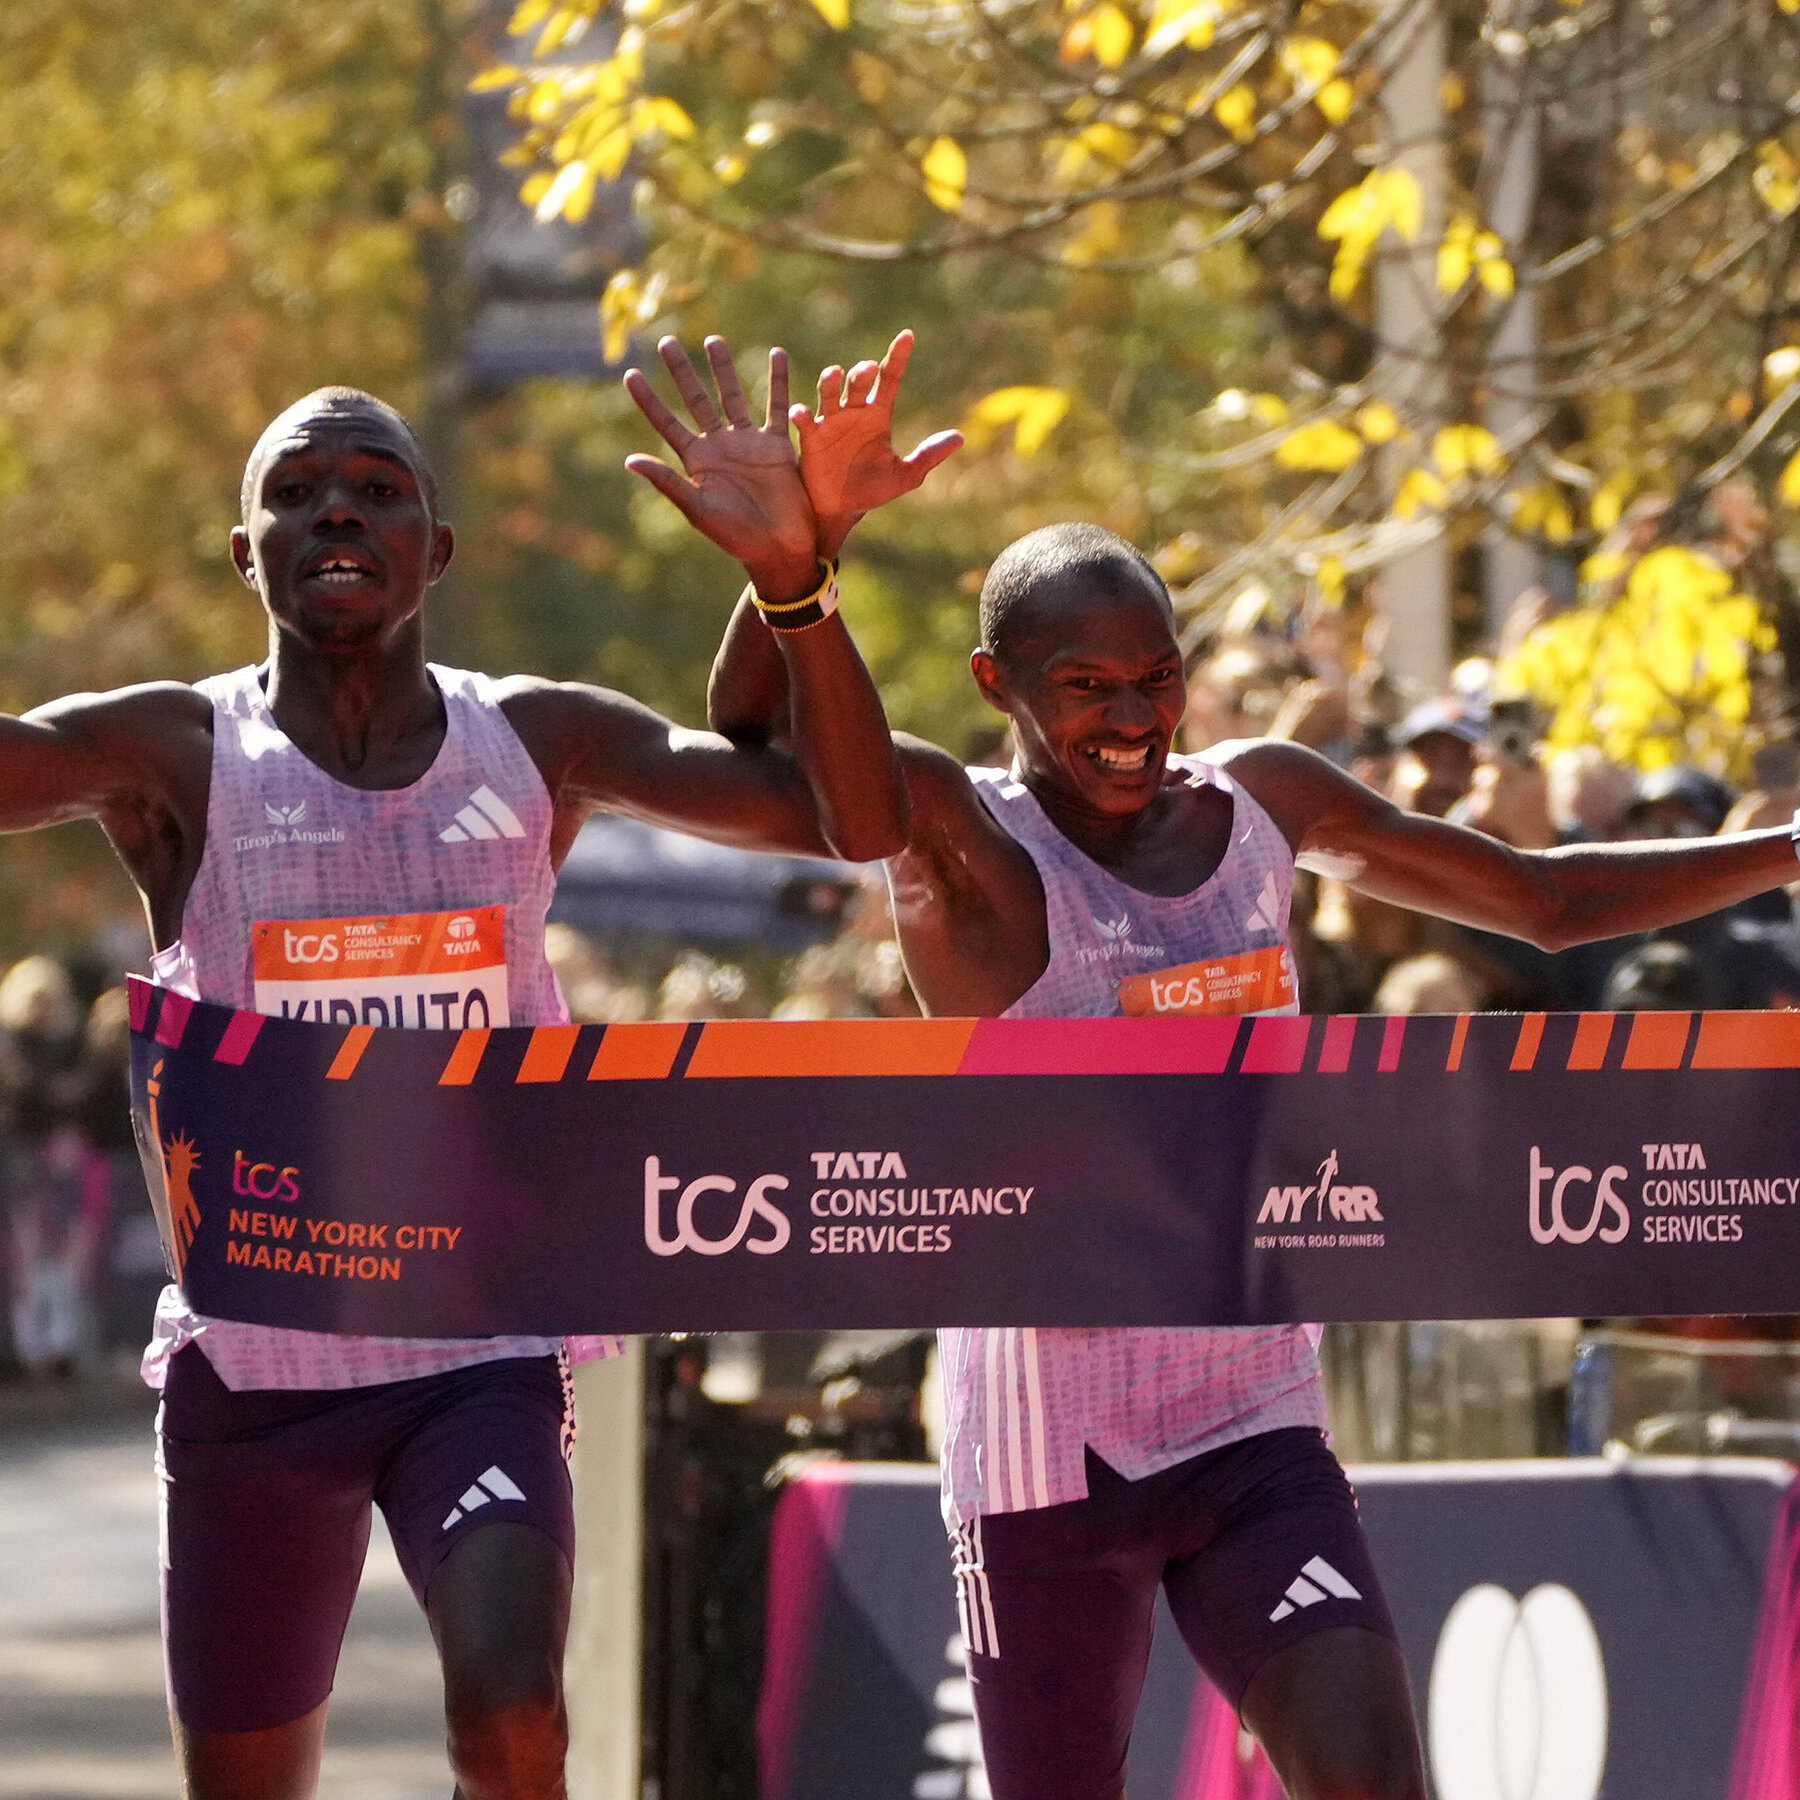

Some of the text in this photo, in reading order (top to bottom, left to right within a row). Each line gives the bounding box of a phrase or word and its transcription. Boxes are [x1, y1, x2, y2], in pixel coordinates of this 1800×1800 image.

[233, 827, 345, 851] Tirop's Angels
[344, 924, 378, 936] TATA
[344, 934, 423, 948] CONSULTANCY
[283, 928, 339, 963] tcs
[344, 949, 395, 961] SERVICES
[443, 940, 482, 956] TATA
[1150, 977, 1204, 1012] tcs
[810, 1151, 908, 1180] TATA
[1641, 1143, 1707, 1171] TATA
[232, 1149, 300, 1202] tcs
[644, 1154, 791, 1257] tcs
[809, 1187, 1035, 1218] CONSULTANCY
[1529, 1145, 1630, 1245] tcs
[1642, 1177, 1800, 1207] CONSULTANCY
[229, 1209, 463, 1251] NEW YORK CITY
[809, 1225, 953, 1255] SERVICES
[1254, 1233, 1386, 1249] NEW YORK ROAD RUNNERS
[1642, 1214, 1744, 1243] SERVICES
[226, 1241, 401, 1281] MARATHON
